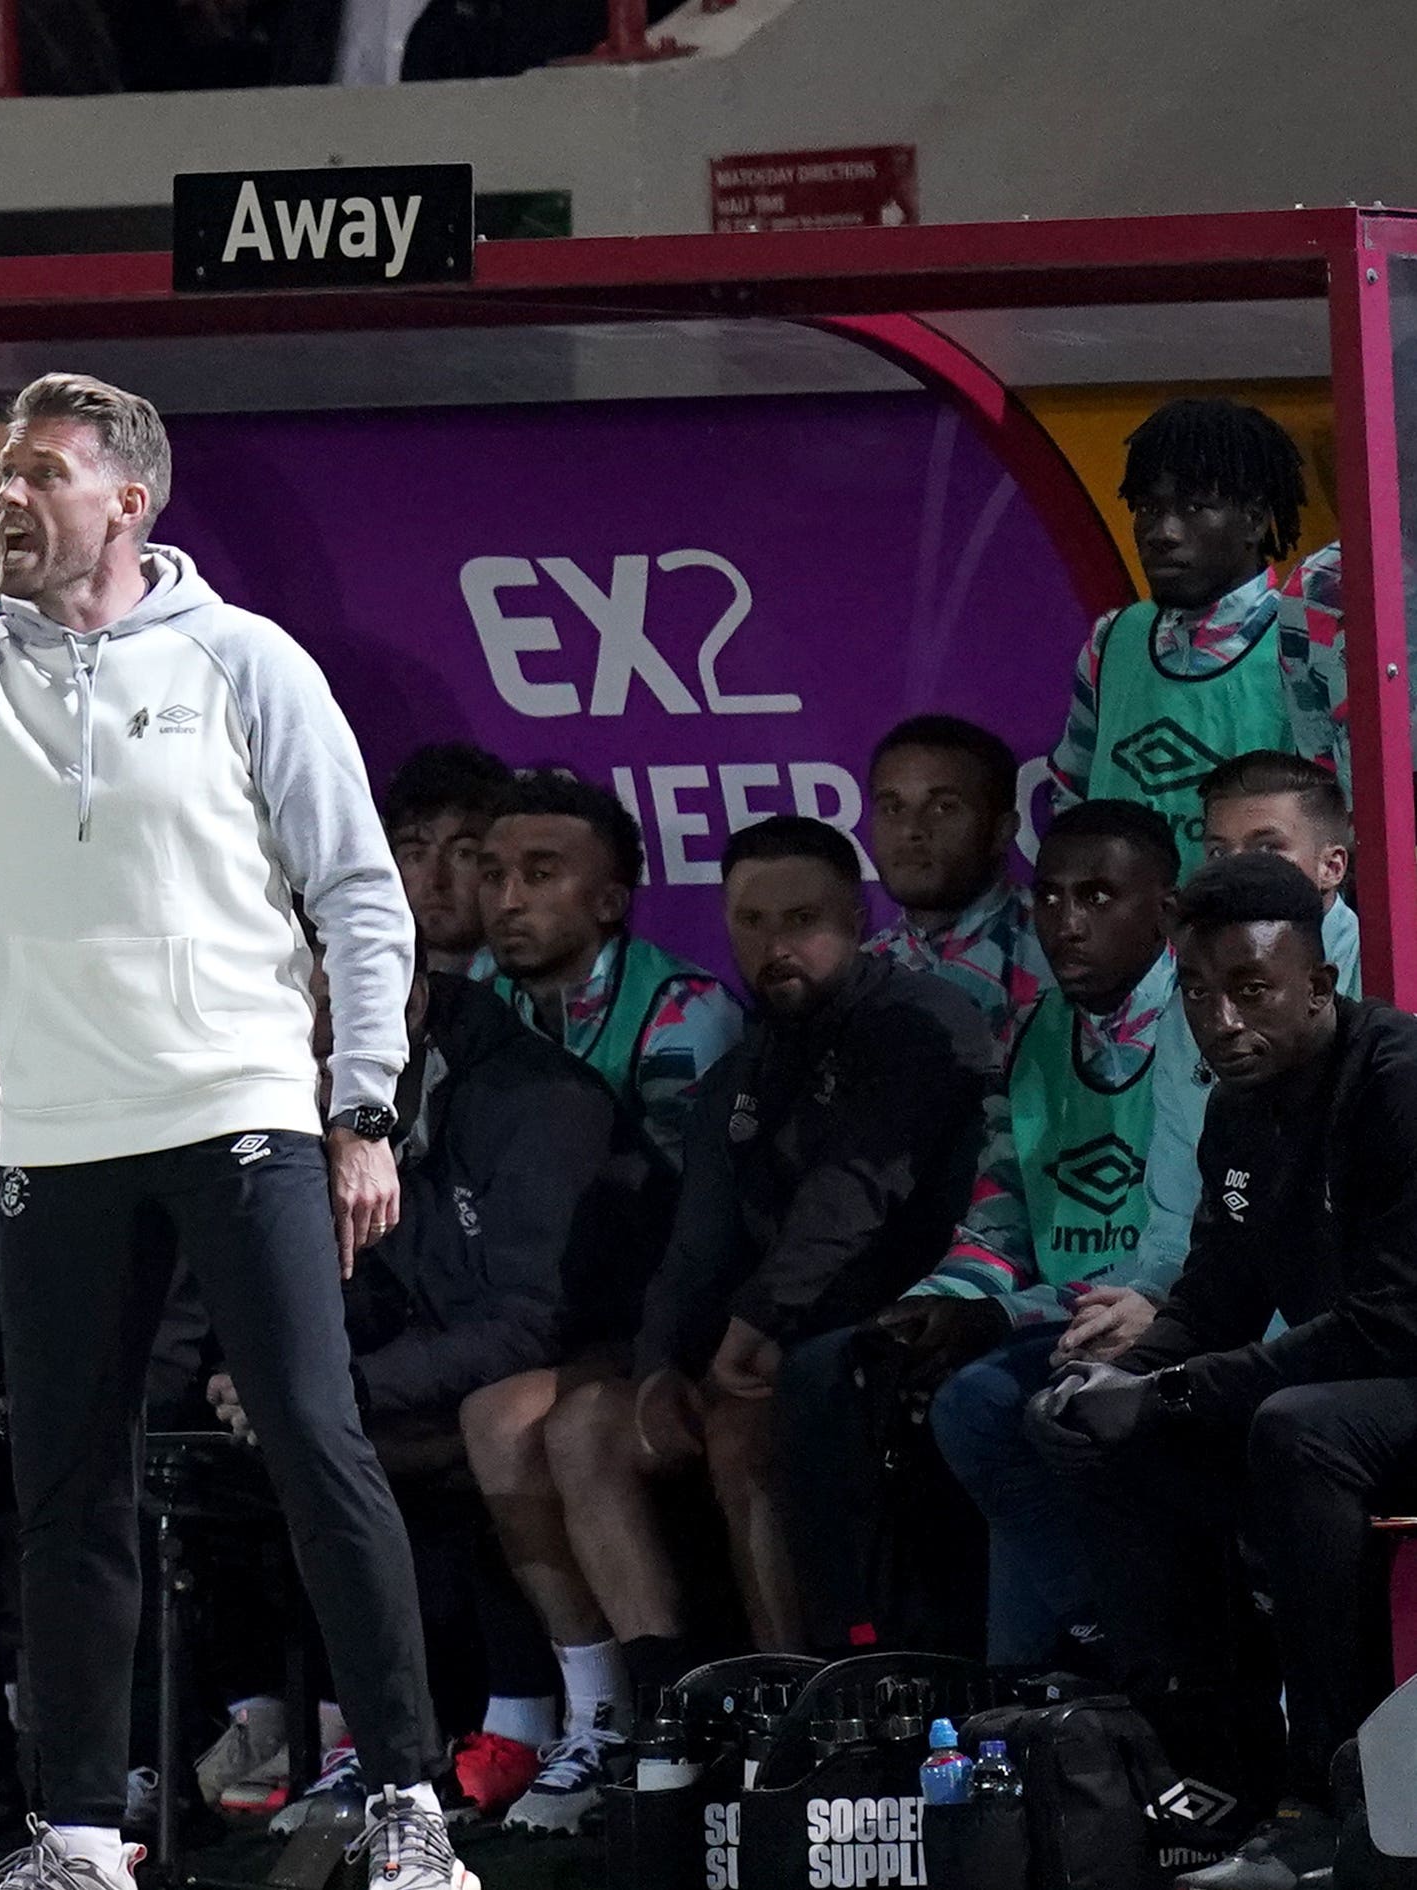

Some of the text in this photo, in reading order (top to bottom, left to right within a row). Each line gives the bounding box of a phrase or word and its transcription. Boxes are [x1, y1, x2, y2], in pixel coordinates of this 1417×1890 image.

[222, 180, 422, 277] Away
[459, 548, 802, 718] EX2
[159, 723, 196, 734] umbro
[238, 1147, 272, 1166] umbro
[1224, 1168, 1251, 1189] DOC
